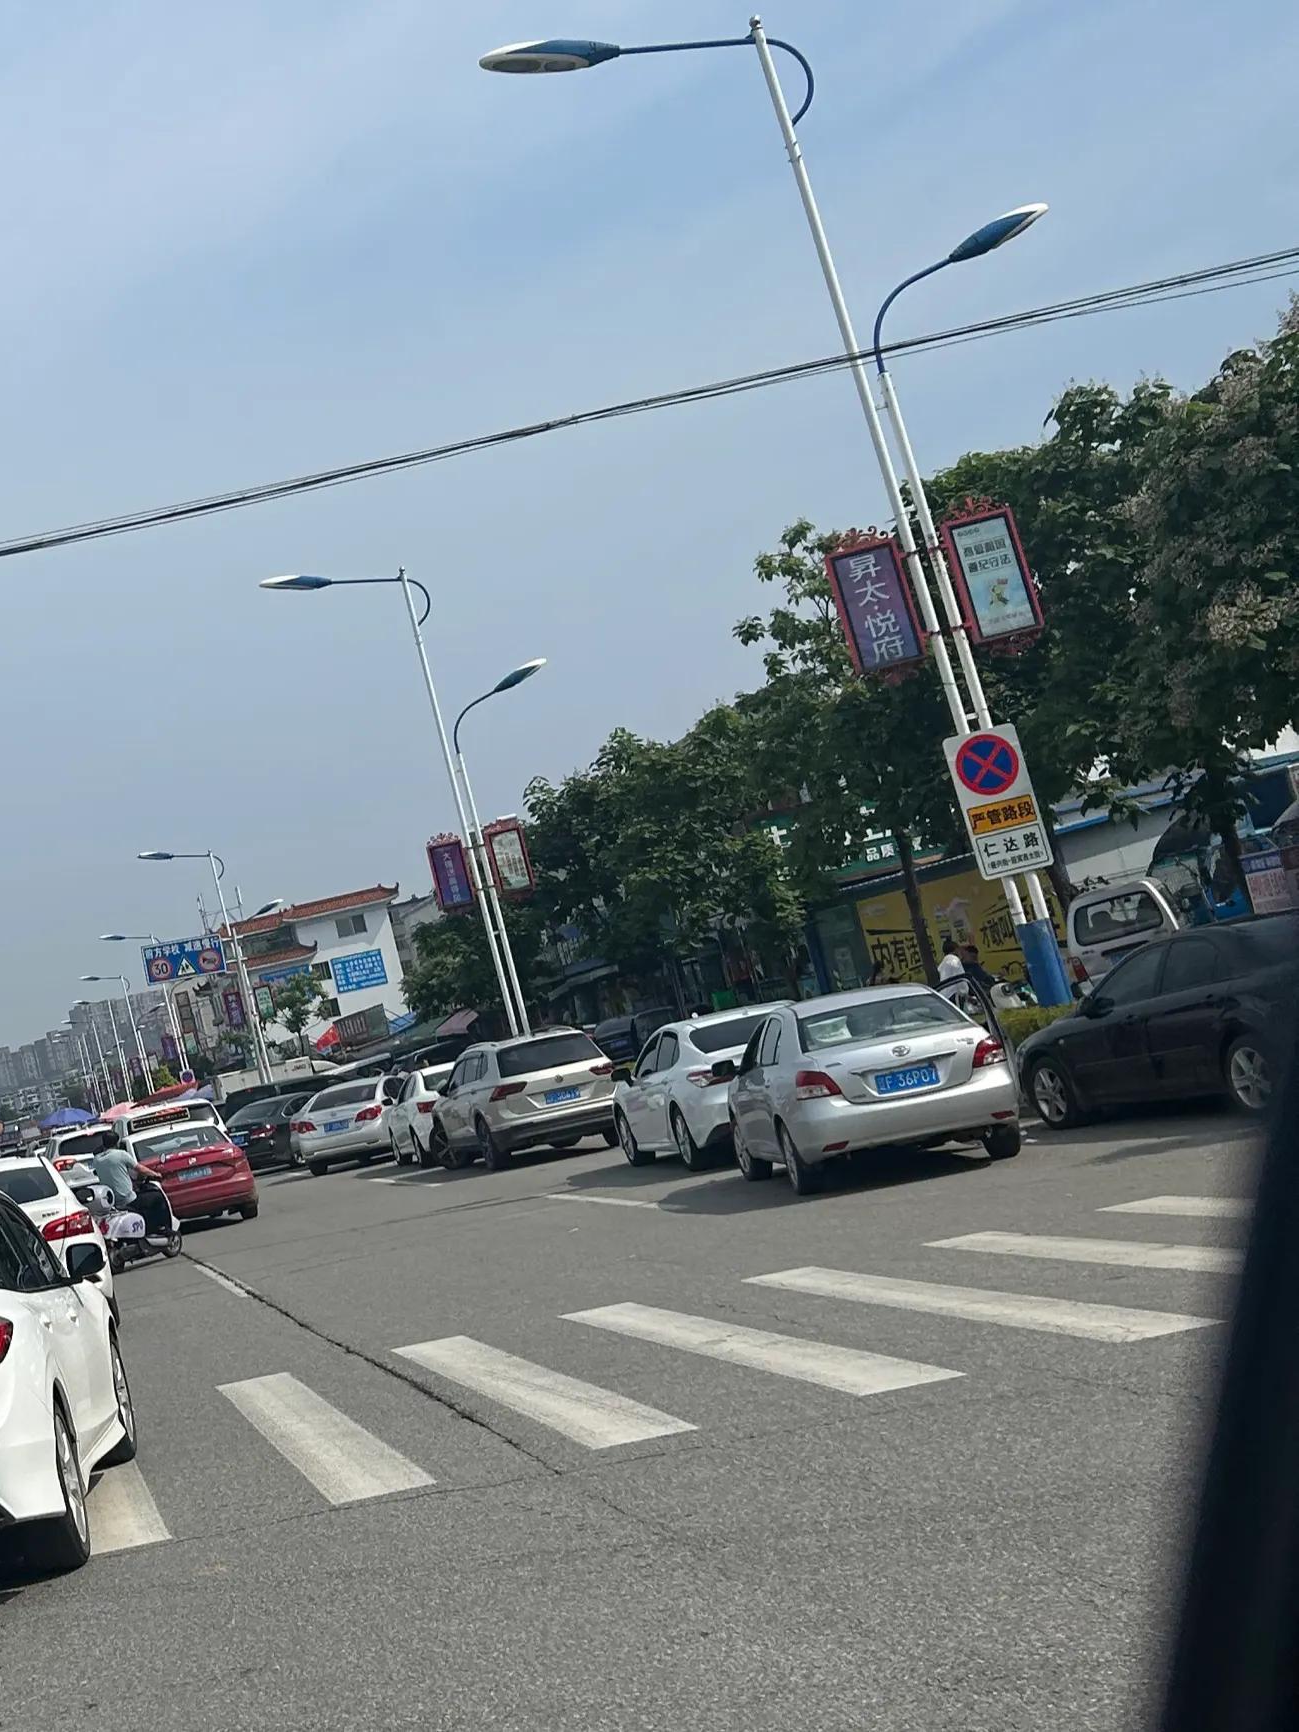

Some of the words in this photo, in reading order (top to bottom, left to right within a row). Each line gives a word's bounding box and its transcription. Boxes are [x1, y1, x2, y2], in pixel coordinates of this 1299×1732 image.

[972, 801, 1034, 830] 严管路段
[983, 832, 1039, 857] 仁达路
[154, 962, 169, 976] 30
